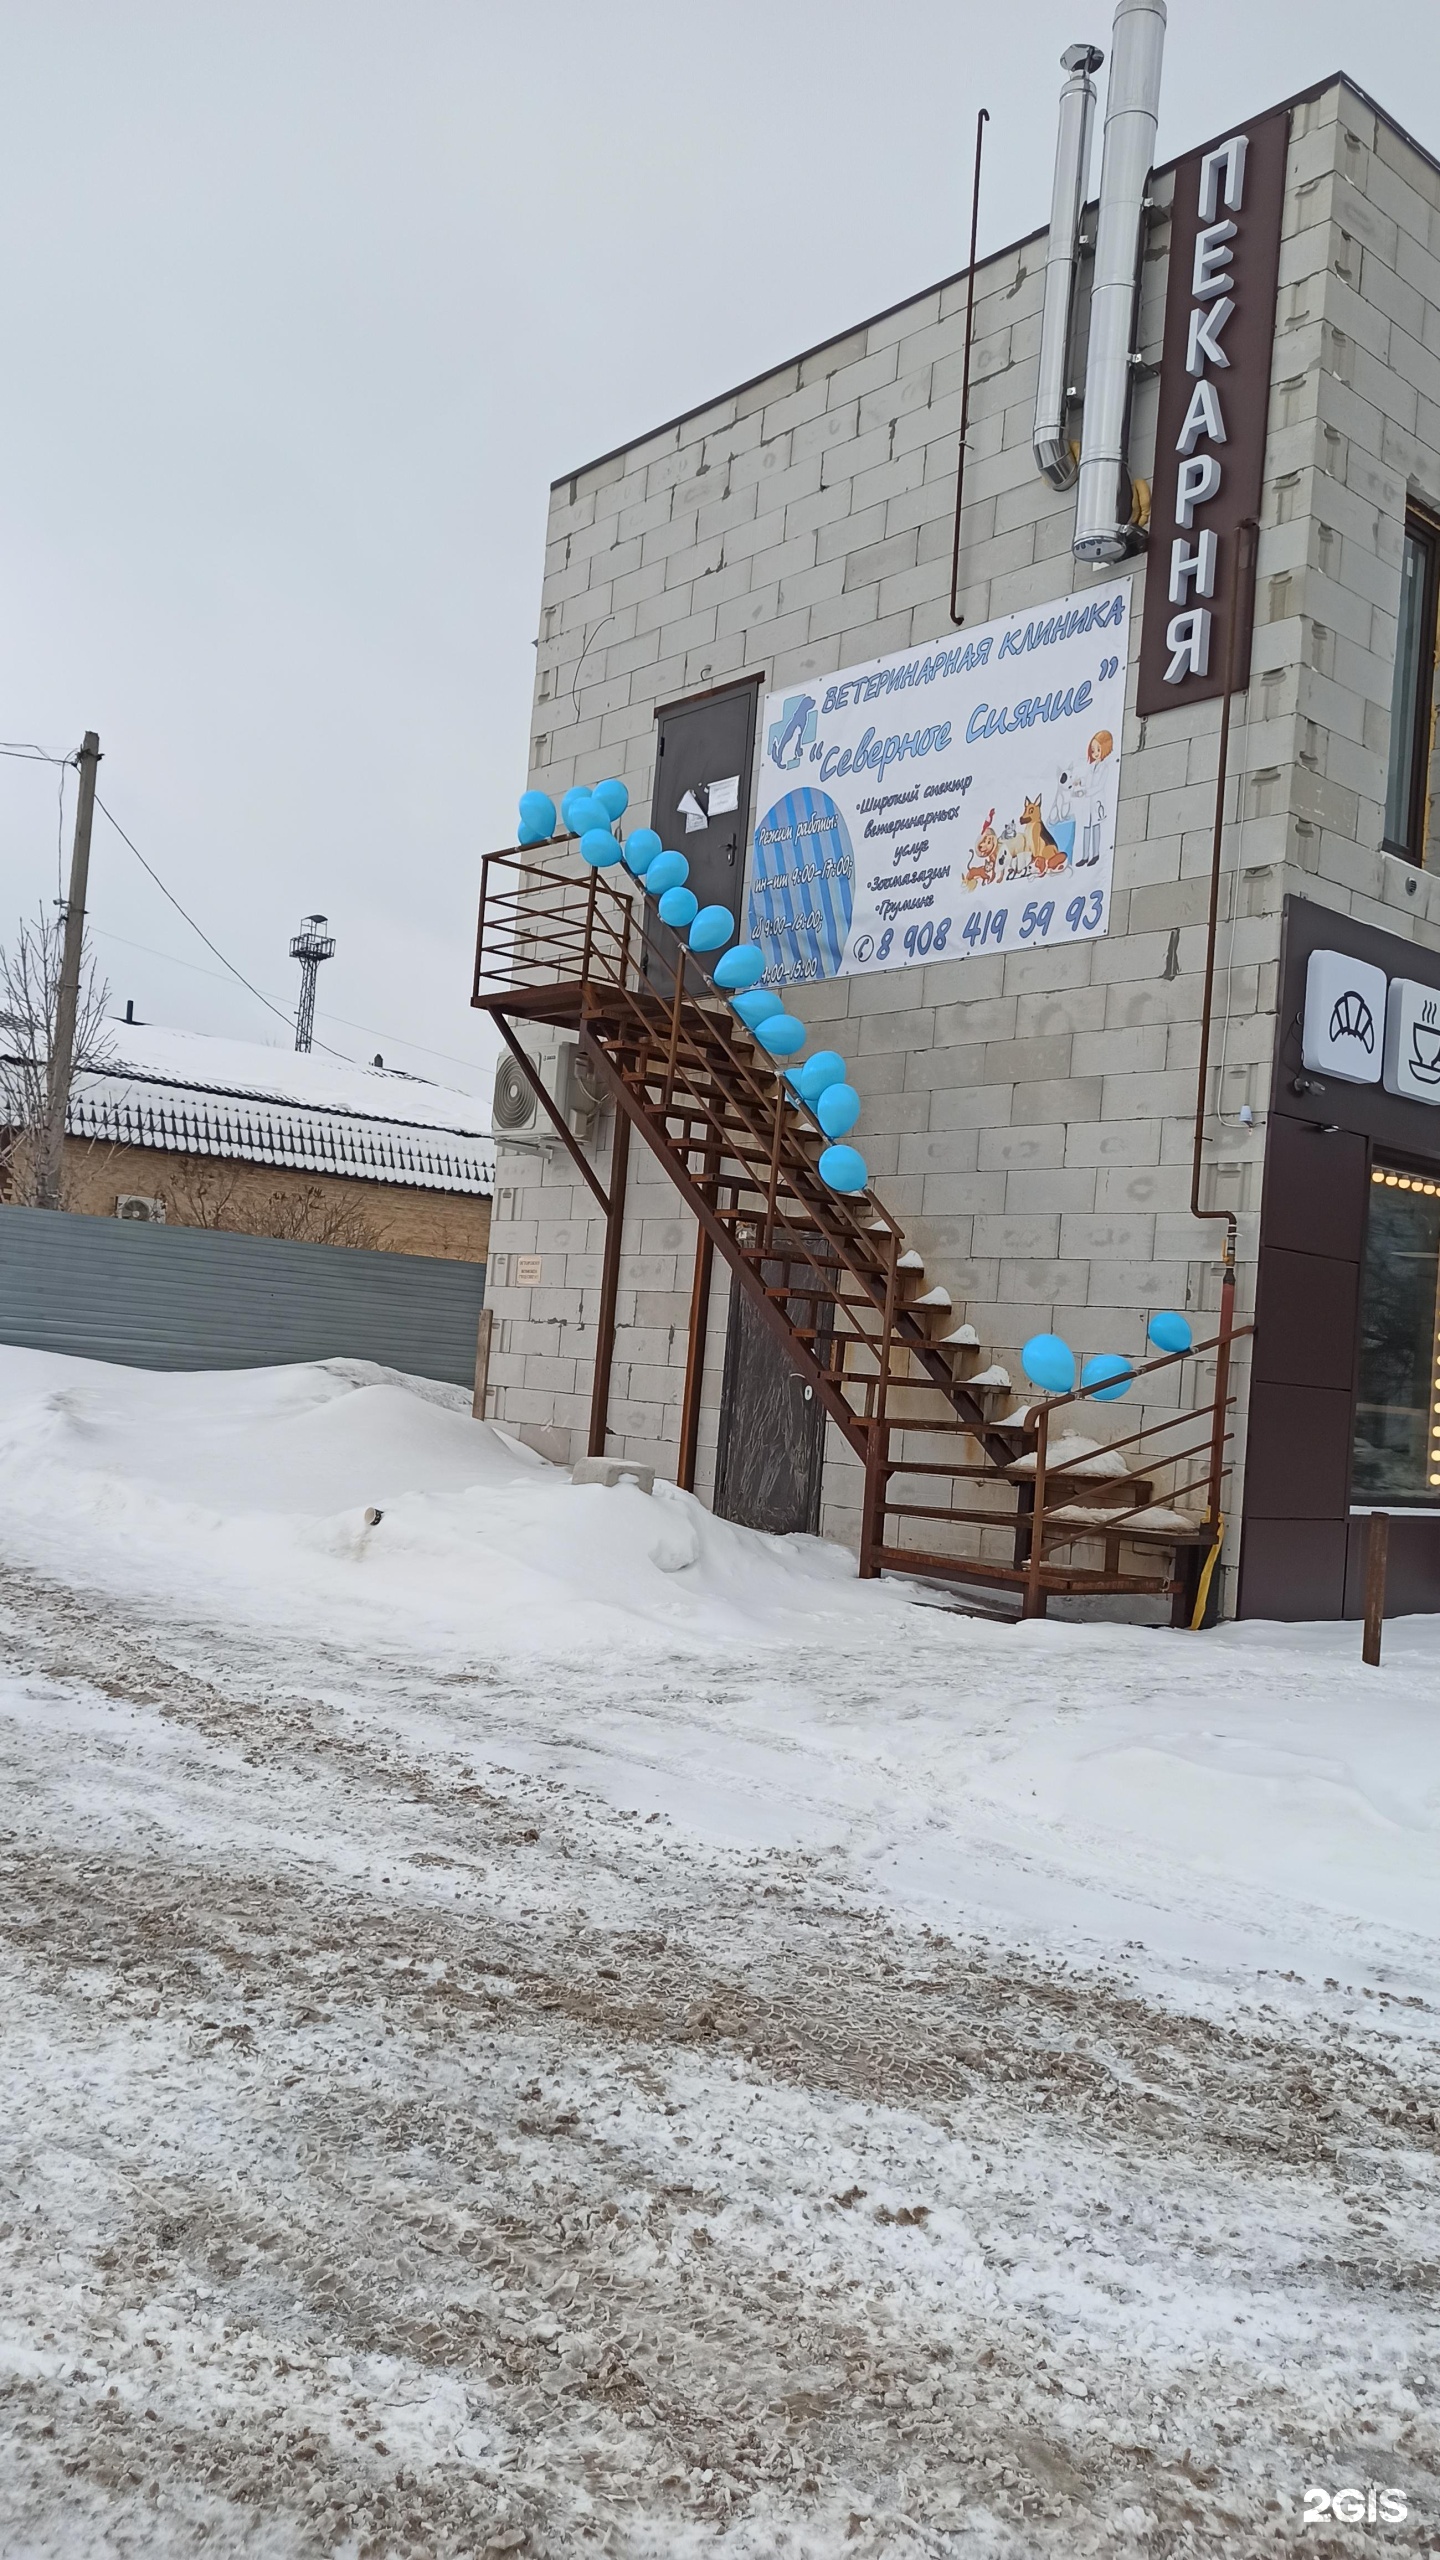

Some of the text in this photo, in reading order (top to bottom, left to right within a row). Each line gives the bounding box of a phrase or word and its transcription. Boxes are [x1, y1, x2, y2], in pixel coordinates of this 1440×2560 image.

[1163, 135, 1249, 684] ПЕКАРНЯ
[821, 595, 1125, 714] ВЕТЕРИНАРНАЯ КЛИНИКА
[860, 775, 973, 815] Широкий спектр
[758, 810, 839, 846] Режим работы:
[864, 806, 960, 839] ветеринарных
[893, 839, 929, 867] услуг
[870, 864, 951, 892] Зоомагазин
[876, 889, 1103, 960] 8 908 419 59 93
[879, 894, 935, 921] Груминг
